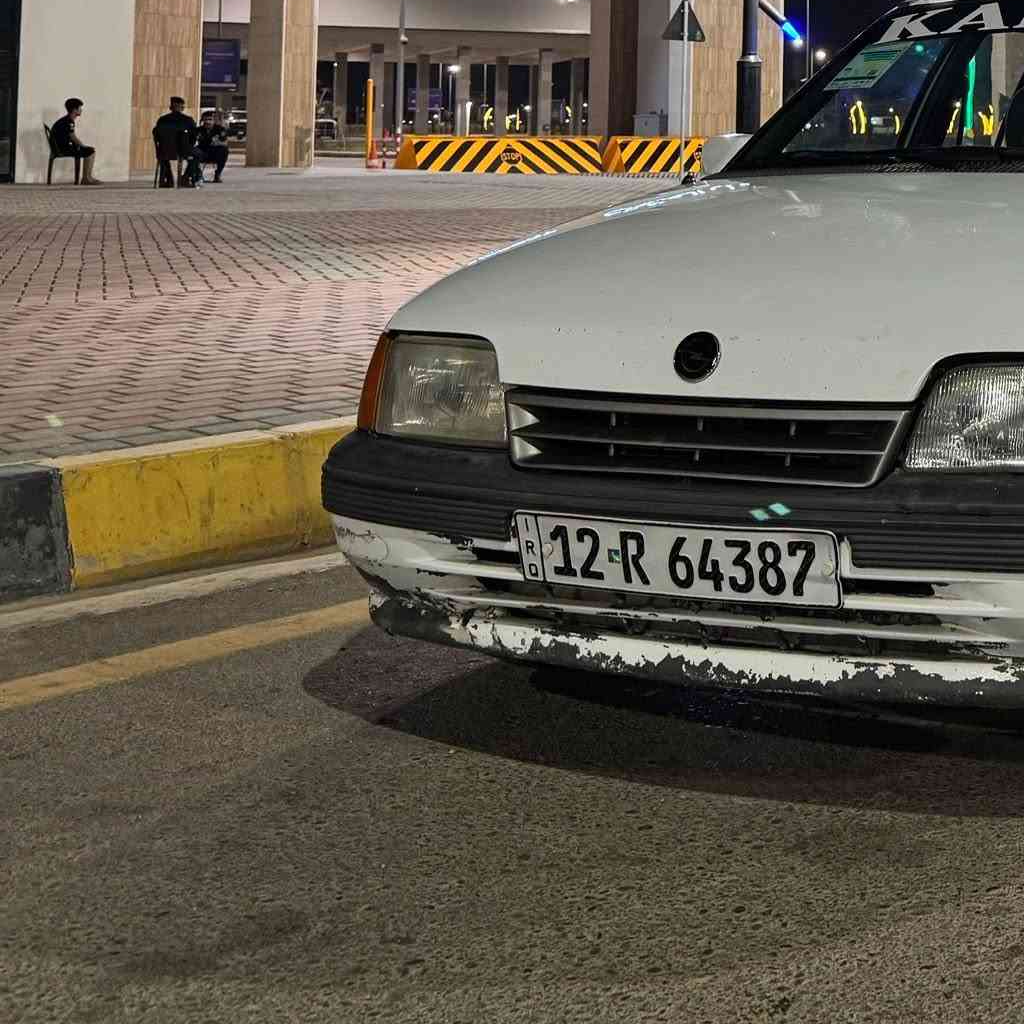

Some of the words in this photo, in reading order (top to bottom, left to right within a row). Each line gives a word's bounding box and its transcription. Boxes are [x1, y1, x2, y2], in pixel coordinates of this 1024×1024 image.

[523, 517, 539, 578] IRQ
[550, 524, 604, 581] 12
[619, 530, 650, 586] R
[668, 536, 816, 597] 64387
